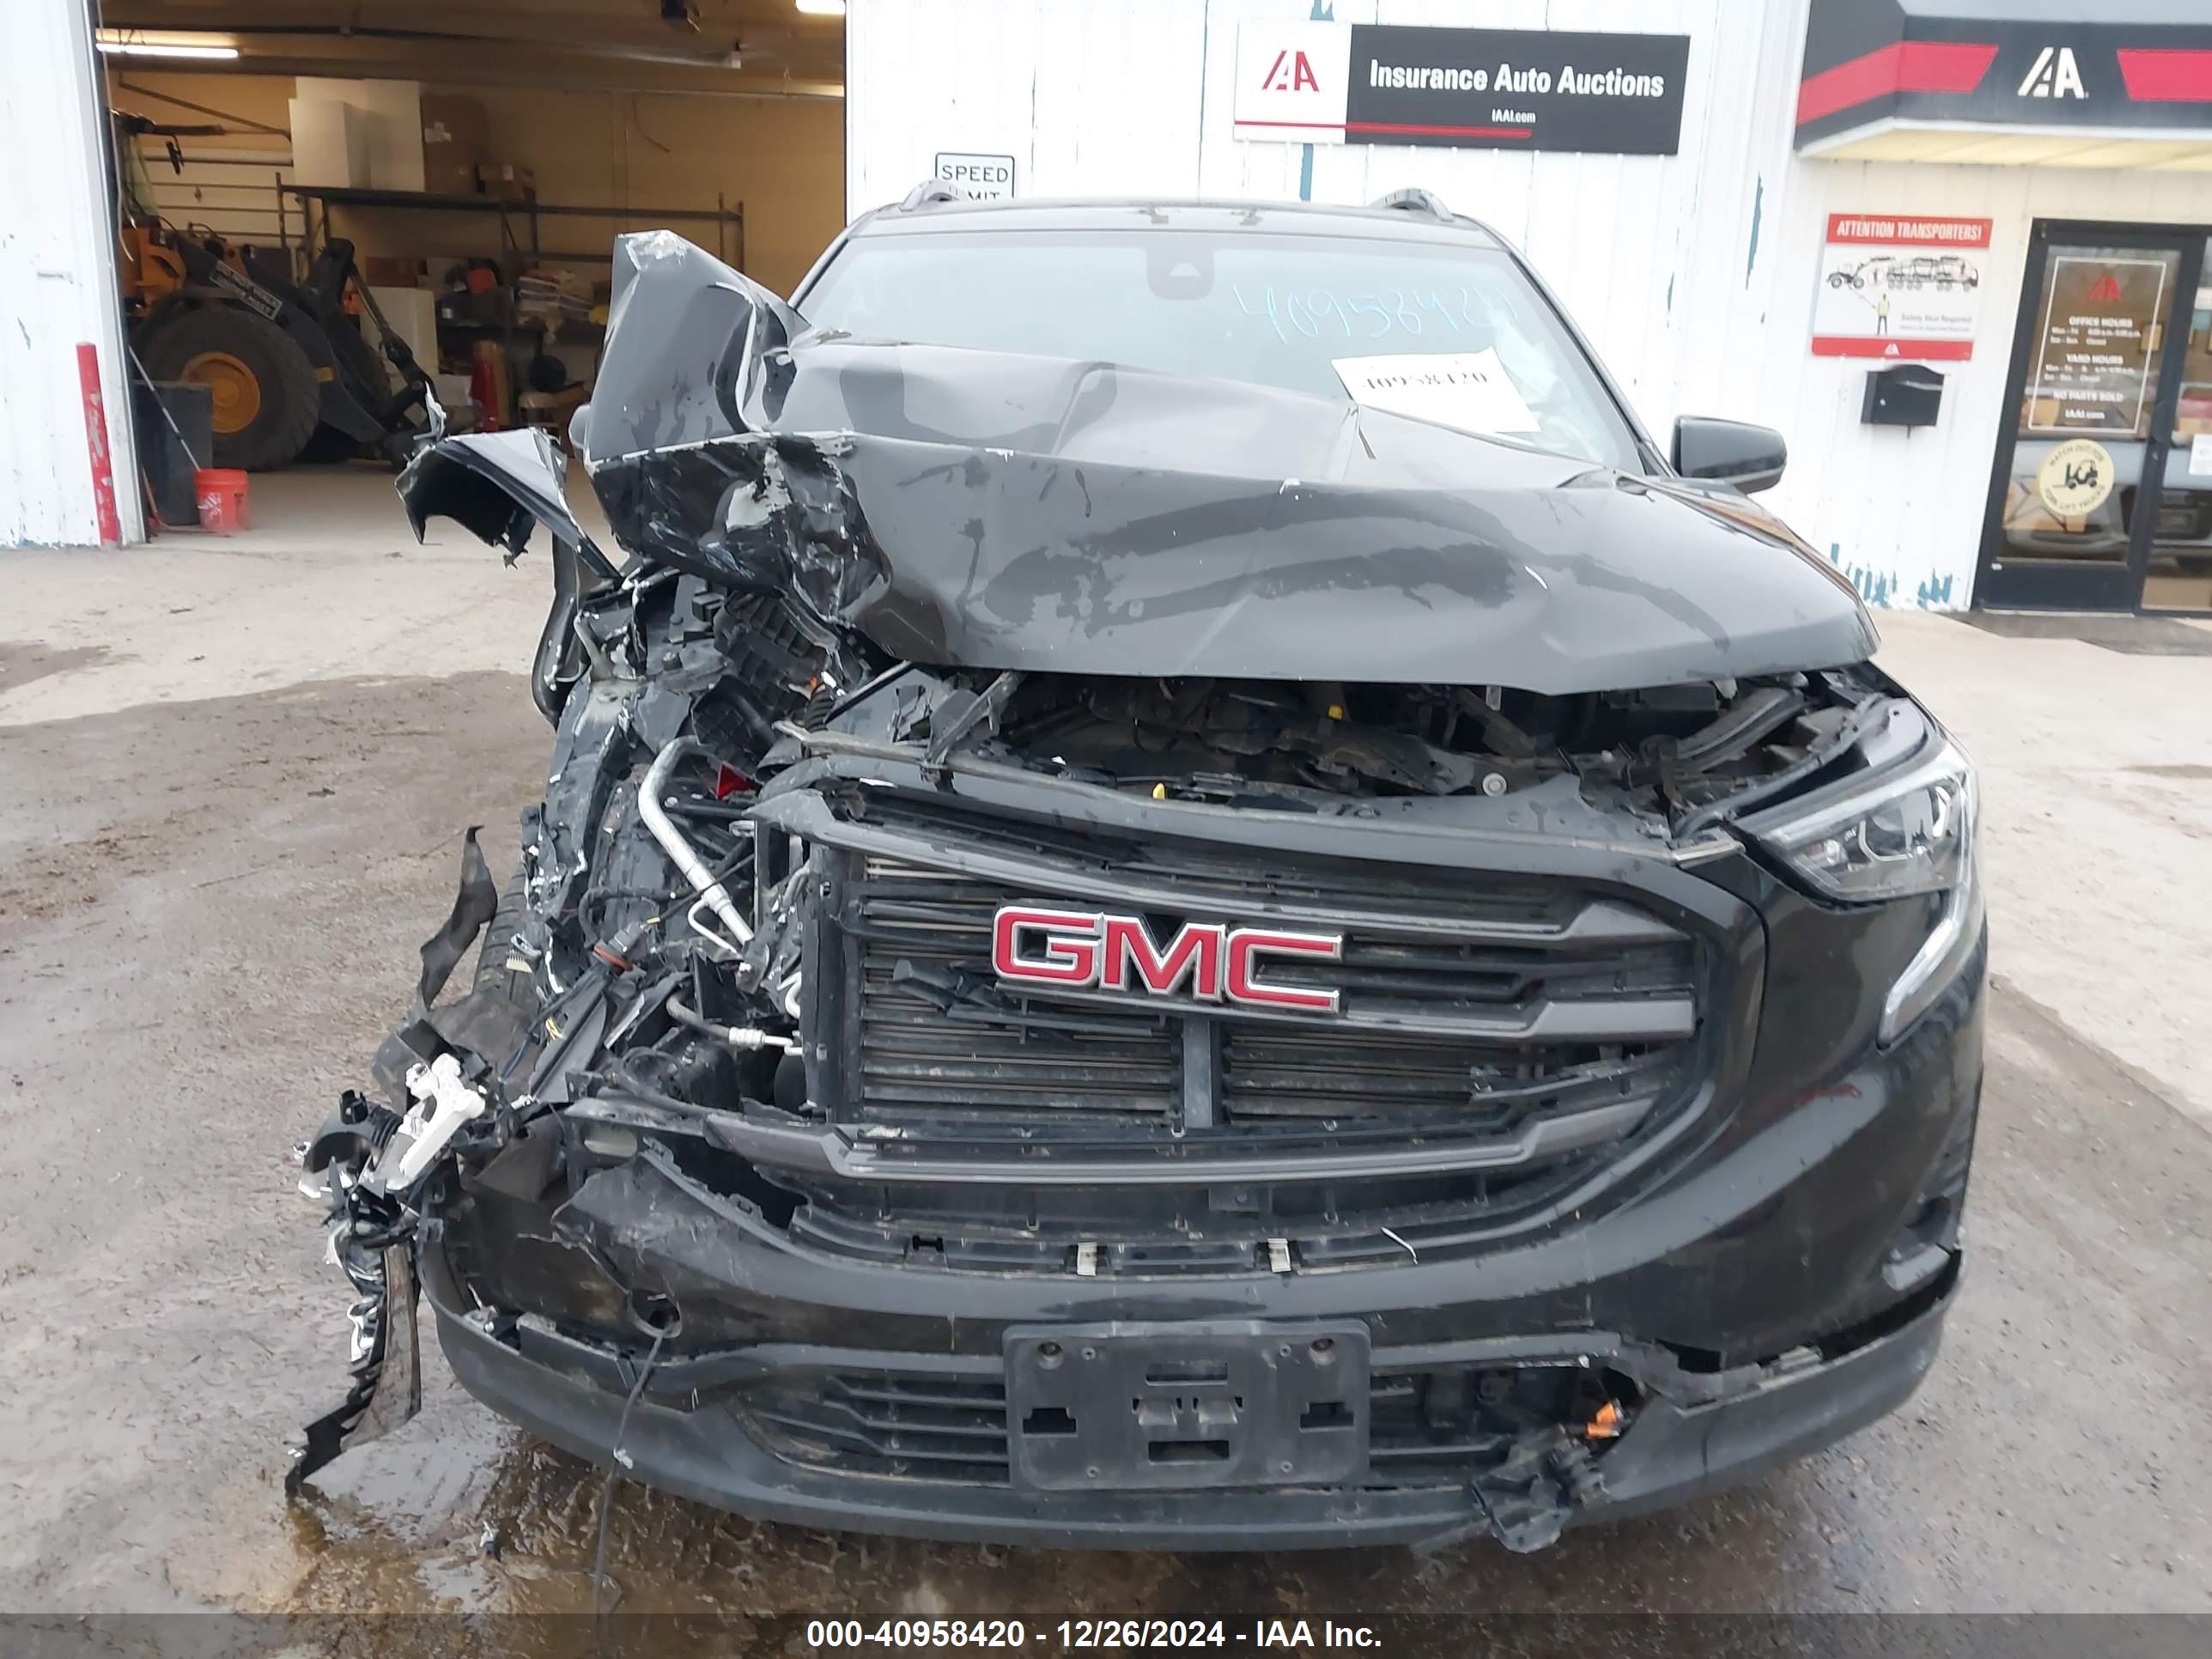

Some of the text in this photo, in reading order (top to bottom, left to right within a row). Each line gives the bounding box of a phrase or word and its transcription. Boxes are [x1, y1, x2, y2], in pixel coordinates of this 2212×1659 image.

[1369, 58, 1665, 98] Insurance Auto Auctions
[1491, 107, 1537, 125] IAAI.com
[942, 164, 1009, 183] SPEED
[1836, 219, 1983, 241] ATTENTION TRANSPORTERS!
[993, 906, 1345, 1013] GMC
